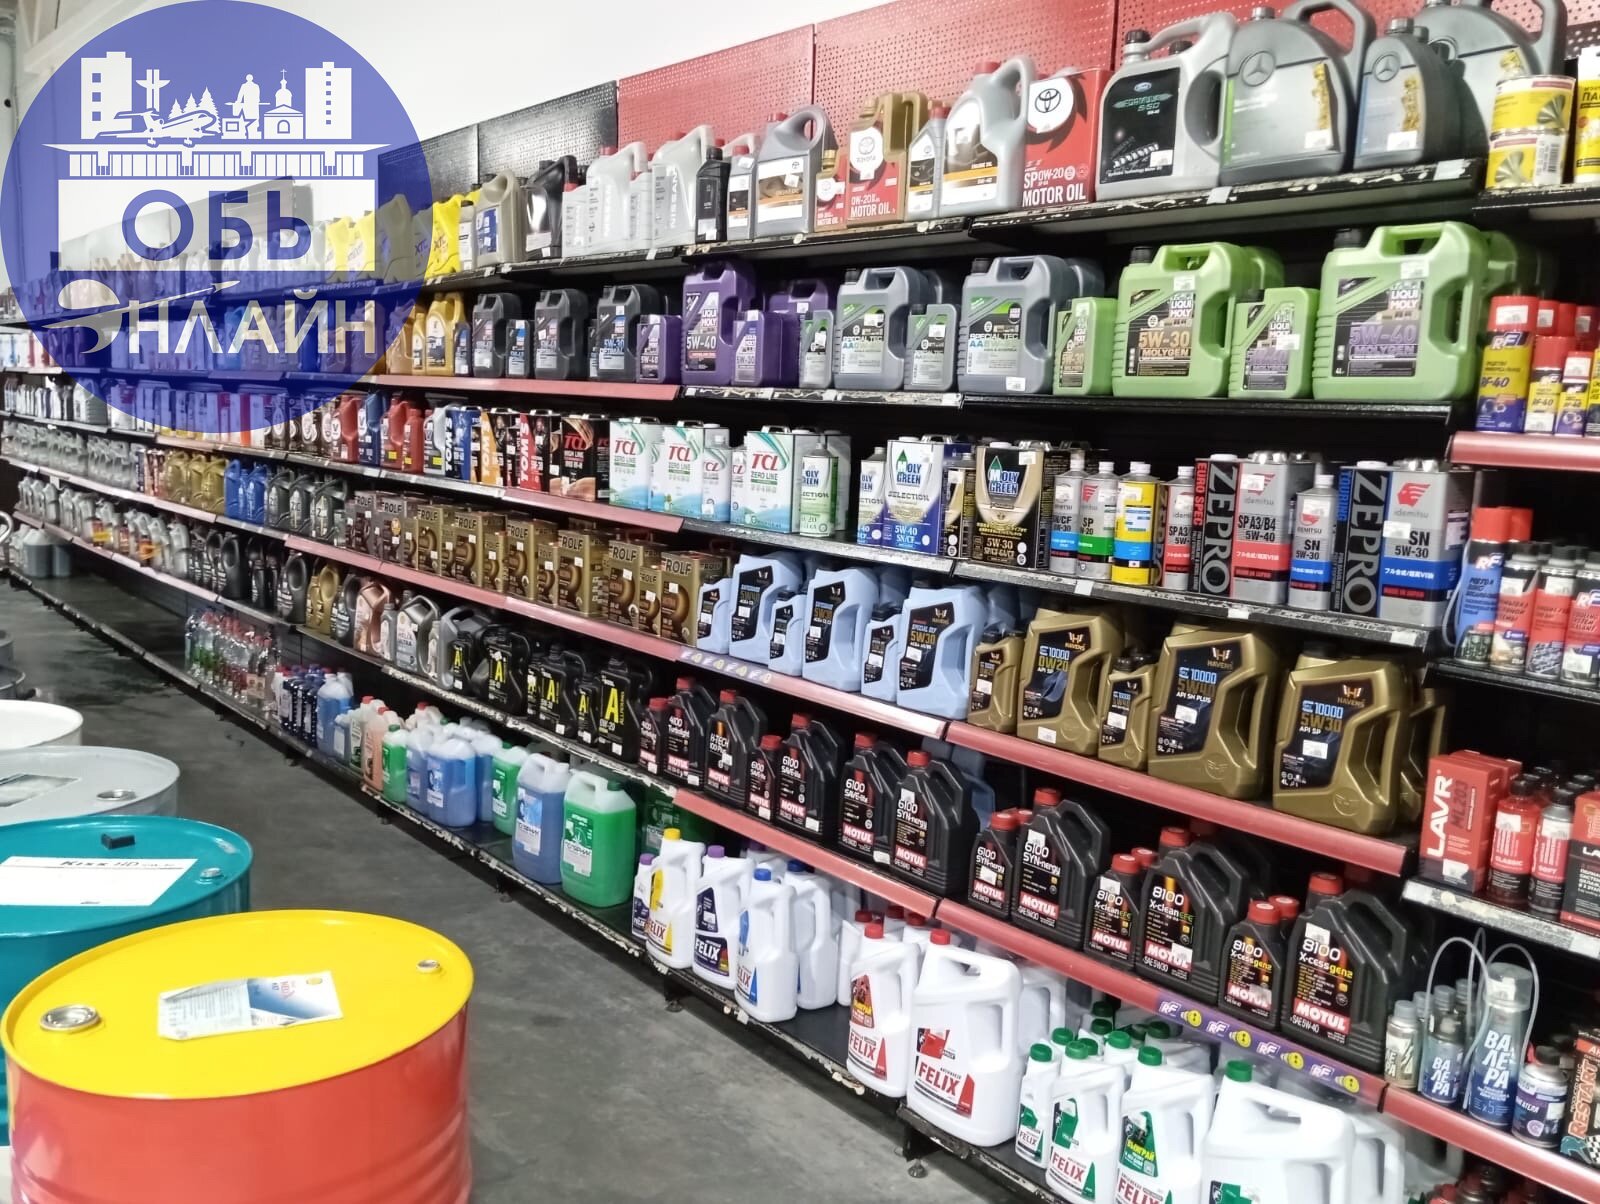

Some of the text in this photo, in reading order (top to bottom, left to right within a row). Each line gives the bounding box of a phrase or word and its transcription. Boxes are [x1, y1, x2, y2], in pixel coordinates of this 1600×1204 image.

[1024, 166, 1063, 189] SP 0W-20
[669, 169, 678, 228] NISSAN
[1023, 184, 1086, 207] MOTOR OIL
[851, 202, 890, 217] MOTOR OIL
[1391, 289, 1418, 300] LIQUI
[1171, 300, 1192, 309] LIQUI
[1390, 300, 1418, 310] MOLY
[1170, 309, 1192, 318] MOLY
[702, 318, 716, 326] MOLY
[1270, 322, 1289, 330] LIQUI
[1139, 330, 1189, 348] 5W-30
[1350, 325, 1416, 344] 5W-40
[1492, 333, 1521, 349] RF
[687, 336, 716, 349] 5W-40
[1354, 345, 1414, 354] MOLYGEN
[1062, 353, 1084, 365] 5W-30
[1142, 348, 1189, 357] MOLYGEN
[445, 417, 454, 471] TOM'S
[520, 422, 530, 481] TOM'S
[615, 440, 636, 455] TCL
[669, 446, 690, 462] TCL
[752, 454, 777, 470] TCL
[897, 461, 922, 473] MOLY
[897, 472, 921, 484] GREEN
[989, 469, 1019, 482] MOLY
[888, 490, 930, 501] SELECTION
[991, 483, 1017, 494] GREEN
[1194, 463, 1207, 526] EURO SPEC
[357, 496, 371, 506] ROLF
[1337, 471, 1352, 522] TOURING
[383, 502, 401, 514] ROLF
[420, 510, 438, 521] ROLF
[458, 517, 477, 529] ROLF
[895, 525, 918, 535] 5W-40
[1083, 517, 1093, 528] SP
[1201, 463, 1238, 593] ZEPRO
[1238, 515, 1276, 531] SP A3/B4
[510, 526, 529, 538] ROLF
[1169, 526, 1176, 537] SP
[1245, 530, 1275, 542] 5W-40
[1409, 530, 1430, 546] SN
[562, 537, 584, 550] ROLF
[987, 538, 1013, 549] 5W-30
[1304, 539, 1320, 550] SN
[1344, 470, 1388, 614] ZEPRO
[612, 548, 636, 562] ROLF
[1296, 550, 1319, 560] 5W-30
[1395, 545, 1429, 558] 5W-30
[664, 559, 692, 576] ROLF
[1476, 553, 1503, 569] RF
[911, 631, 935, 645] 5W30
[1049, 648, 1070, 660] 10000
[1038, 656, 1068, 672] 0W20
[1191, 668, 1217, 684] 10000
[1196, 695, 1211, 704] PLUS
[1314, 702, 1343, 719] 10000
[1300, 712, 1342, 732] 5W30
[710, 734, 729, 748] H-TECH
[668, 755, 689, 769] MOTUL
[751, 761, 764, 772] 6100
[783, 756, 799, 768] 6100
[709, 769, 730, 785] MOTUL
[846, 779, 865, 792] 6100
[781, 800, 805, 815] MOTUL
[898, 800, 917, 814] 6100
[897, 809, 927, 830] SYN-nergy
[1427, 775, 1453, 857] LAVR
[844, 825, 872, 842] MOTUL
[897, 847, 924, 866] MOTUL
[977, 847, 996, 860] 6100
[1025, 842, 1049, 859] 6100
[1023, 853, 1061, 876] SYN-nergy
[975, 883, 1004, 901] MOTUL
[1097, 890, 1124, 906] 8100
[1152, 886, 1184, 906] 8100
[1021, 895, 1057, 917] MOTUL
[1094, 900, 1120, 914] X-clean
[1149, 899, 1179, 917] X-clean
[1093, 932, 1128, 952] MOTUL
[1233, 940, 1263, 958] 8100
[695, 939, 720, 961] FELIX
[1302, 939, 1340, 961] 8100
[1299, 952, 1353, 979] X-cess gen2
[1160, 1001, 1181, 1016] RF
[1291, 1015, 1302, 1025] SAE
[1296, 1003, 1345, 1031] MOTUL
[1207, 1021, 1229, 1037] RF
[850, 1032, 876, 1060] FELIX
[1485, 1030, 1512, 1050] ВА
[1257, 1042, 1280, 1057] RF
[1311, 1063, 1334, 1079] RF
[1433, 1057, 1451, 1070] ВА
[918, 1062, 959, 1096] FELIX
[1484, 1070, 1509, 1089] РА
[1432, 1083, 1450, 1096] РА
[1568, 1059, 1598, 1138] RESTART
[1019, 1131, 1037, 1147] FELIX
[1052, 1152, 1085, 1182] FELIX
